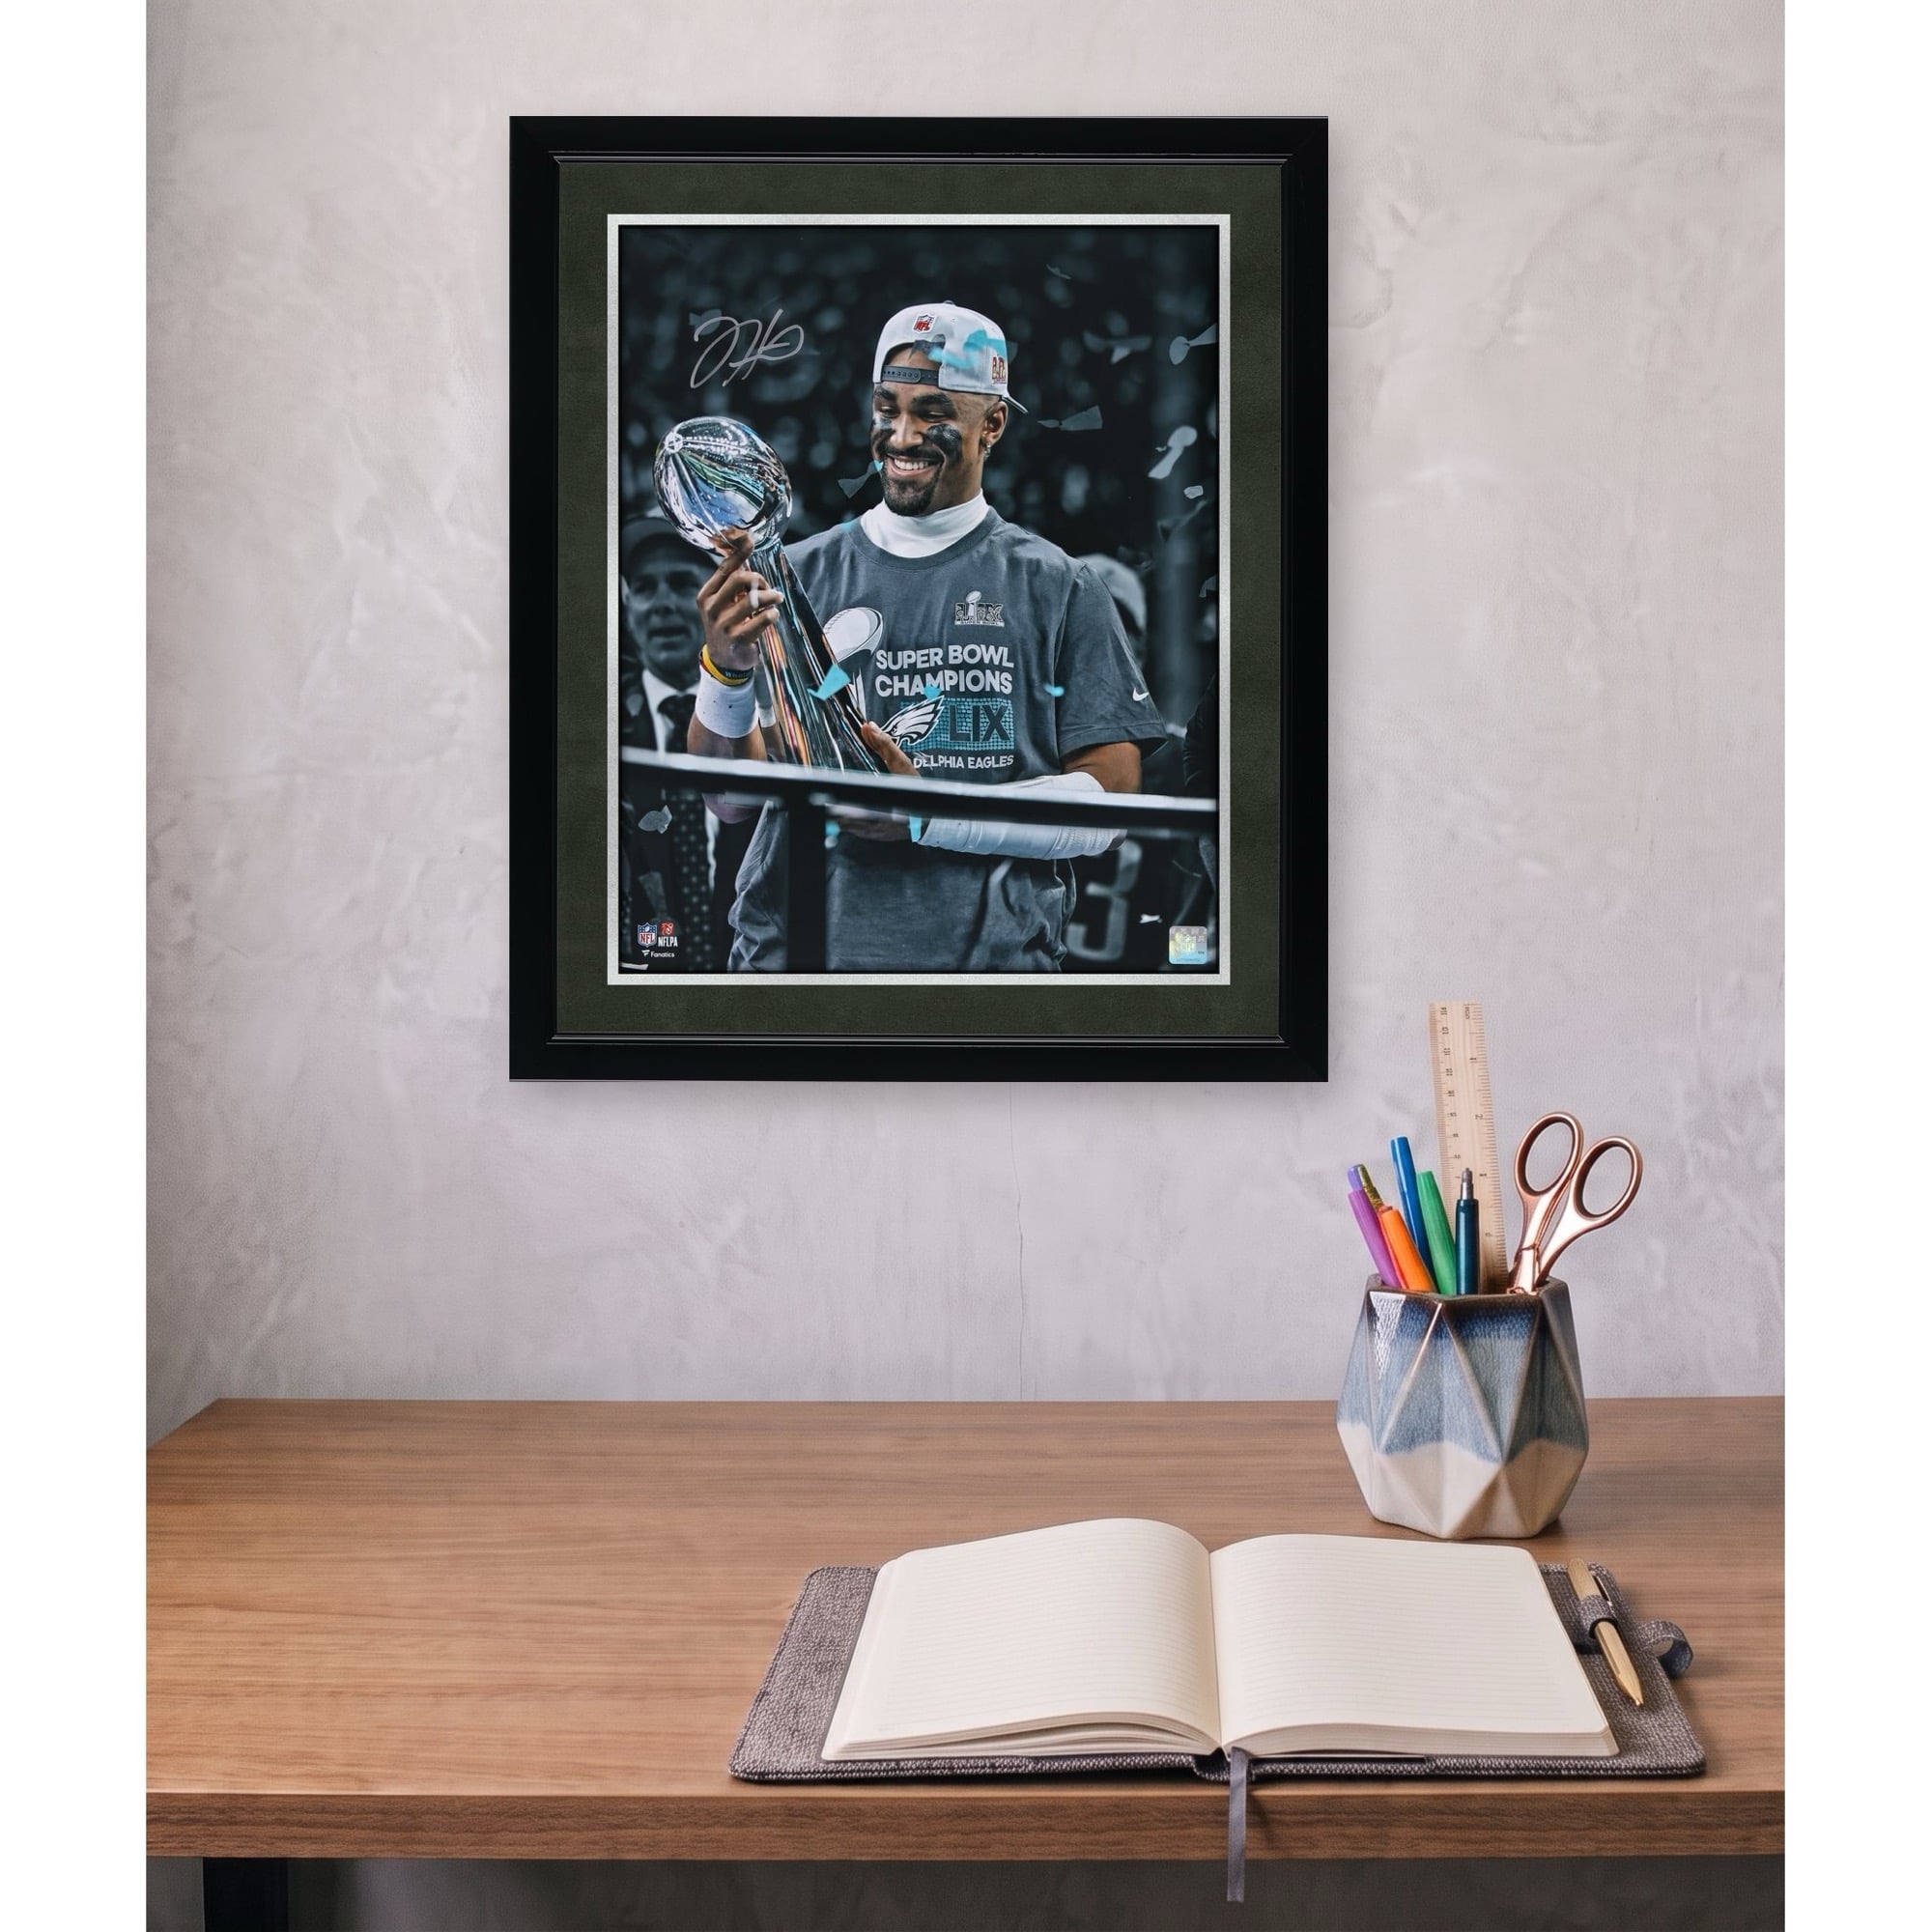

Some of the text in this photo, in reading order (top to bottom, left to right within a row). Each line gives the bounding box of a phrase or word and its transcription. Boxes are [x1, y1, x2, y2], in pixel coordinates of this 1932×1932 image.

[875, 643, 1014, 670] SUPER BOWL
[874, 668, 1013, 697] CHAMPIONS
[948, 704, 1010, 743] LIX
[967, 754, 1014, 769] EAGLES
[639, 933, 655, 944] NFL
[658, 936, 678, 948] NFLPA
